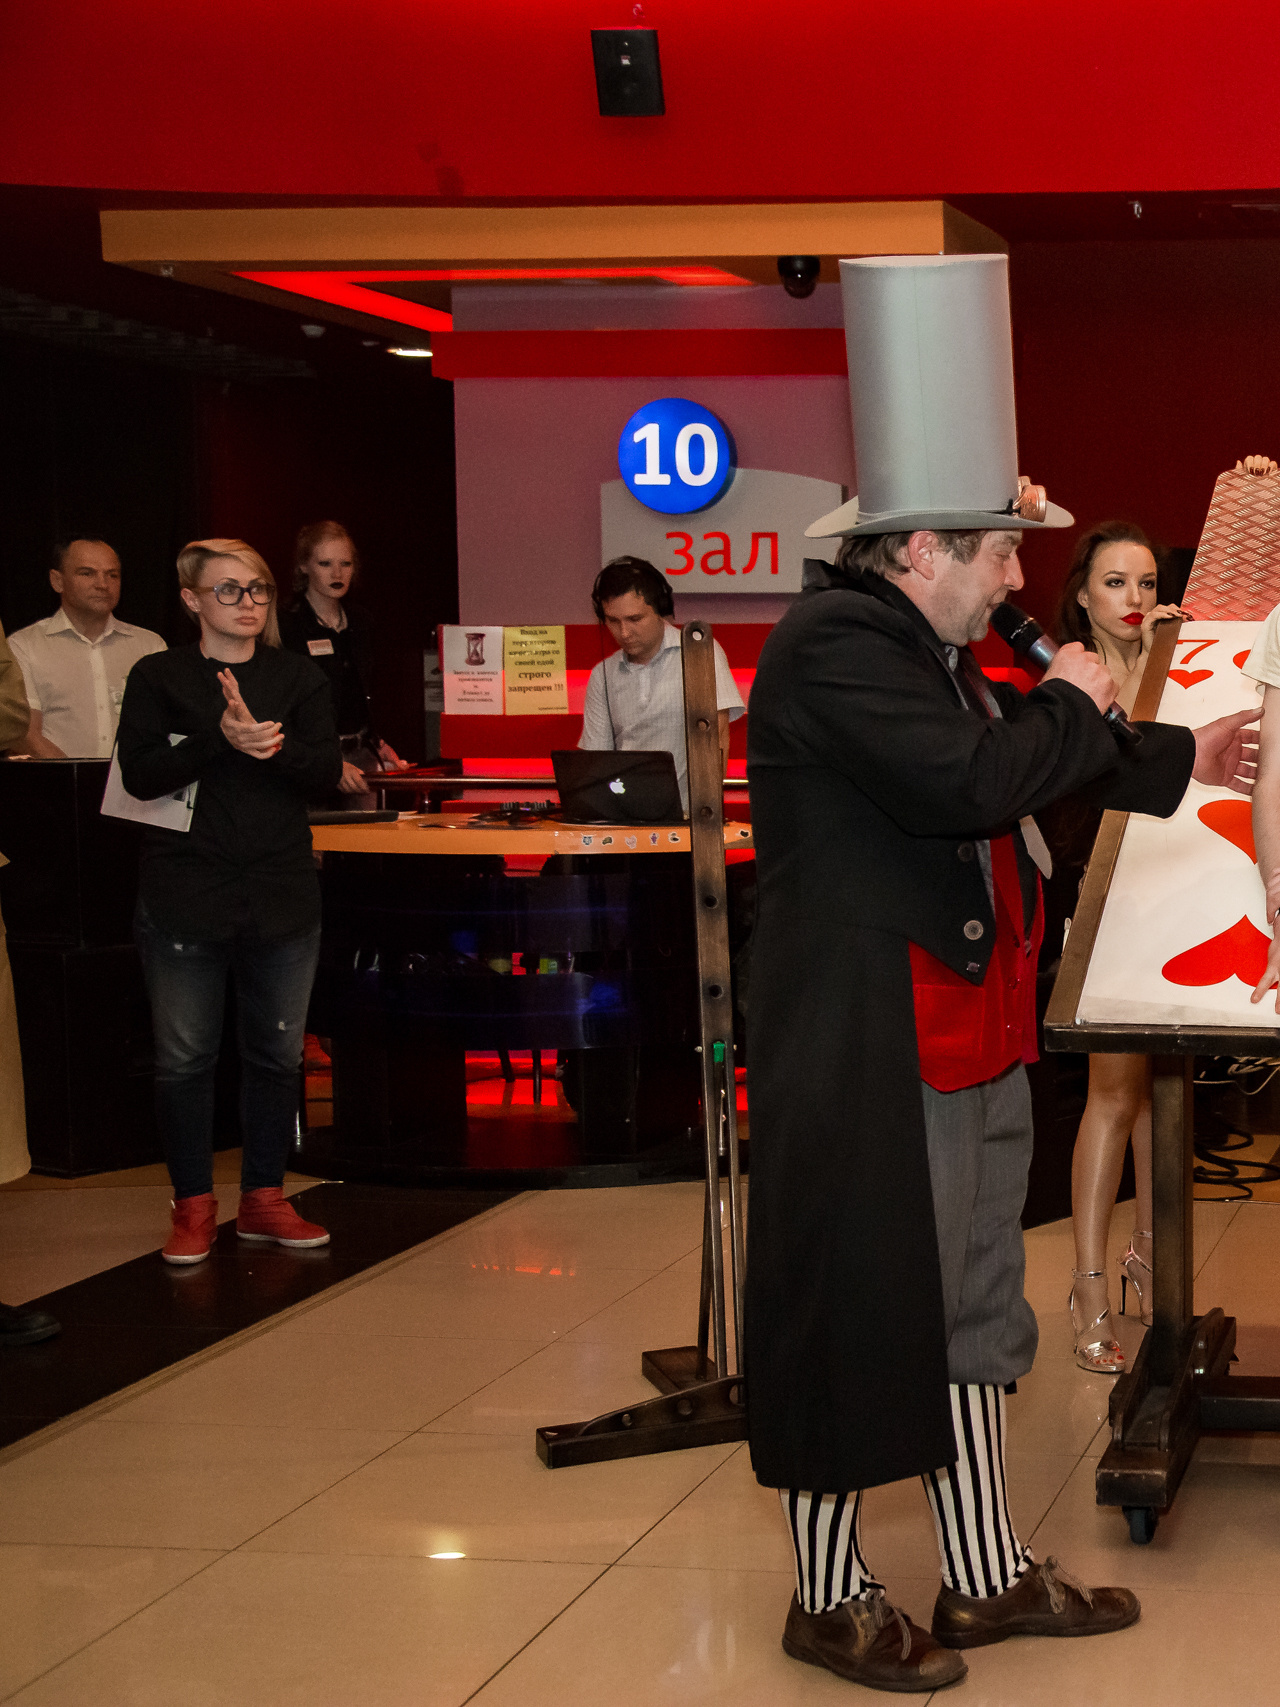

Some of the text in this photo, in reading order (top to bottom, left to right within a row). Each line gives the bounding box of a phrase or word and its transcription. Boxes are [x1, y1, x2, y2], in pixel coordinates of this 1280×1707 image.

[633, 422, 718, 486] 10
[665, 531, 779, 576] зал
[1176, 639, 1220, 664] 7
[518, 672, 552, 680] строго
